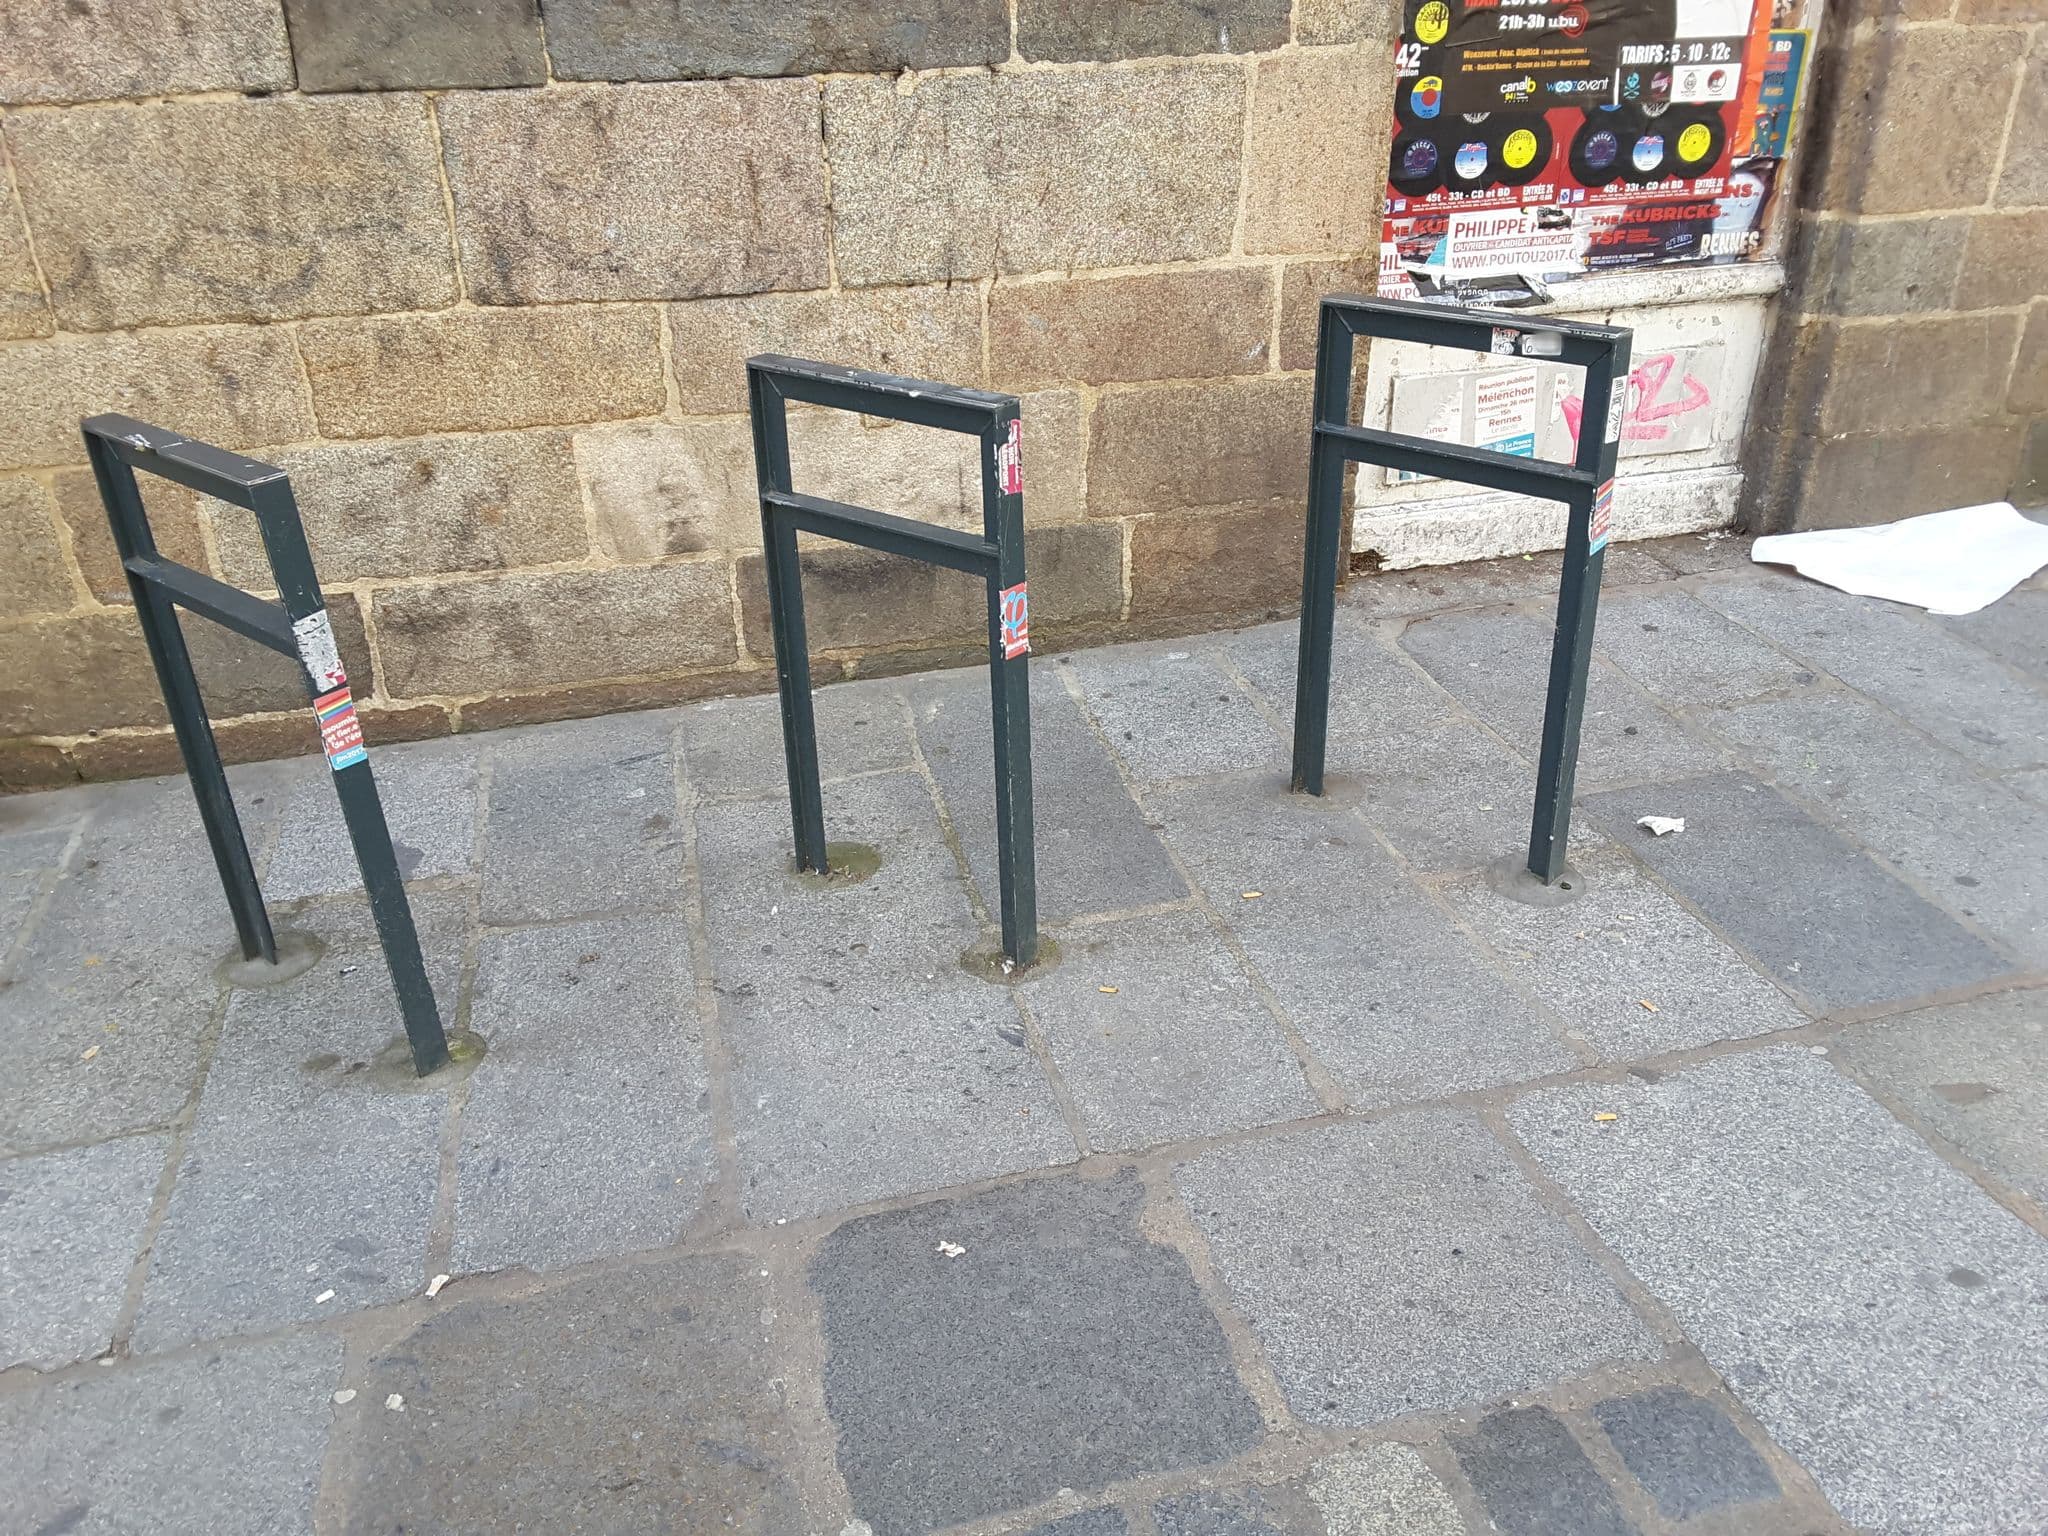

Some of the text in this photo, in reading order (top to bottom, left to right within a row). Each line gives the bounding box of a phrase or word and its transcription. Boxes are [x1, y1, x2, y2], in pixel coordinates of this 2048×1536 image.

[1500, 14, 1579, 29] 21h-3h ubu
[1396, 43, 1421, 68] 42
[1671, 43, 1680, 62] 5
[1688, 43, 1704, 62] 10
[1625, 182, 1639, 192] 33t
[1646, 181, 1659, 191] CD
[1660, 180, 1670, 189] et
[1671, 179, 1684, 190] BD
[1449, 191, 1463, 201] 33t
[1471, 189, 1484, 200] CD
[1486, 189, 1497, 198] et
[1498, 188, 1510, 198] BD
[1592, 204, 1722, 227] THE KUBRICKS
[1454, 218, 1528, 239] PHILIPPE
[1453, 242, 1487, 252] OUVRIER
[1494, 238, 1531, 249] CANDIDAT
[1589, 229, 1626, 246] TSF
[1701, 231, 1760, 258] RENNES
[1506, 375, 1535, 388] publique
[1478, 402, 1508, 414] Dimanche
[1489, 414, 1522, 428] Rennes
